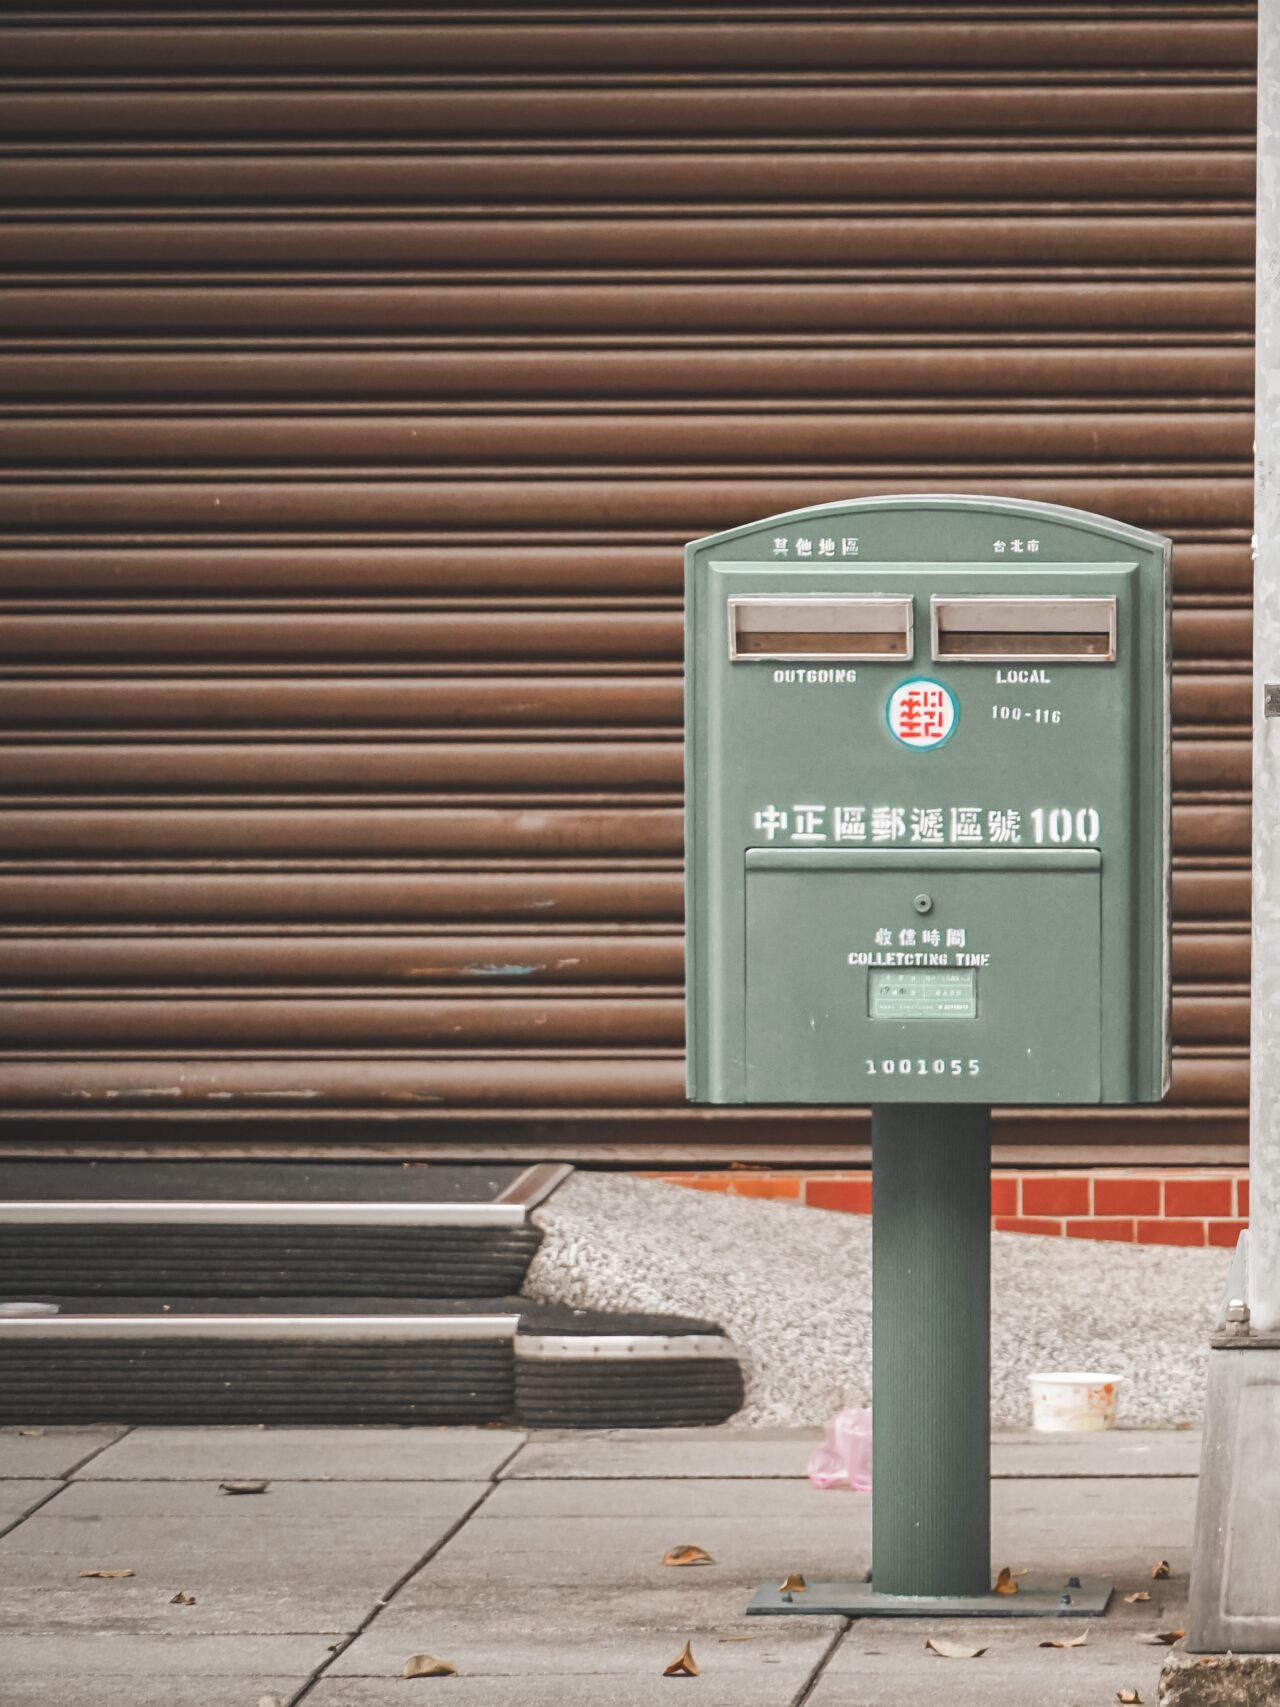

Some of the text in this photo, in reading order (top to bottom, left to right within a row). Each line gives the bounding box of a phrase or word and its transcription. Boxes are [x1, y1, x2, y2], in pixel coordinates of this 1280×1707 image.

[773, 537, 859, 557] 其他地區
[992, 538, 1040, 553] 台北市
[773, 669, 857, 683] OUTGOING
[995, 669, 1051, 684] LOCAL
[992, 705, 1062, 724] 100-116
[751, 804, 1101, 844] 中正區郵遞區號 100
[874, 927, 966, 948] 收信時間
[848, 952, 990, 966] COLLETCTING TIME
[866, 1059, 980, 1076] 1001055
